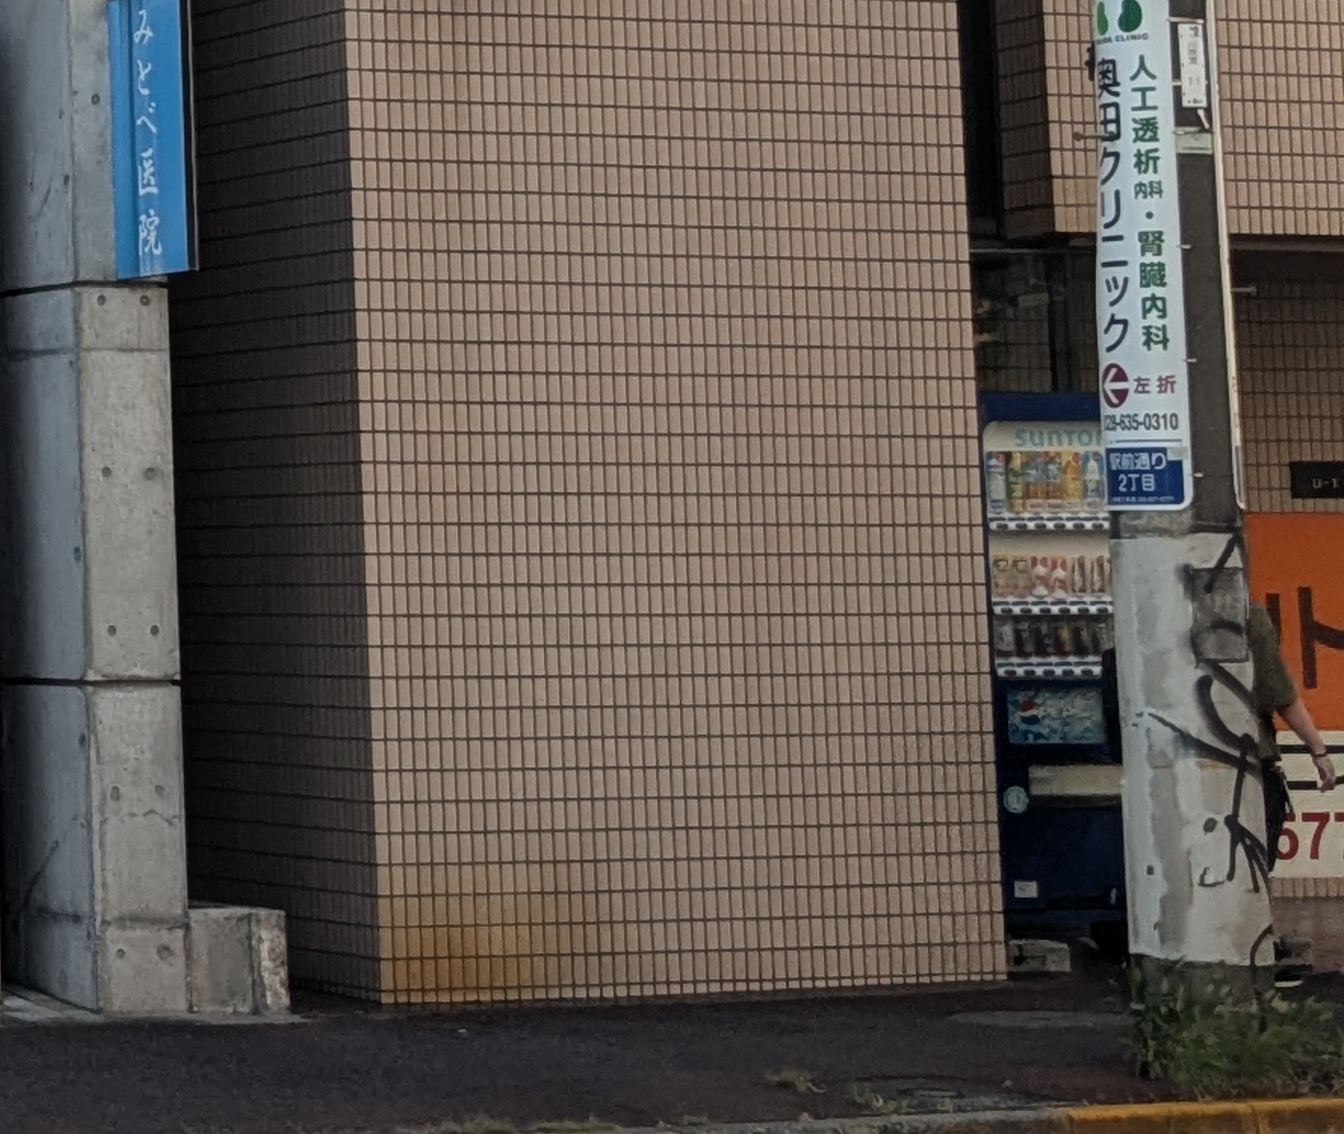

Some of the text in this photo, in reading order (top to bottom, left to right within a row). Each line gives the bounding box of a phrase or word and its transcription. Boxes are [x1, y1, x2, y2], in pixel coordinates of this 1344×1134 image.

[133, 9, 162, 256] みとべ医院
[1097, 56, 1129, 354] 奥田クリニック
[1133, 374, 1177, 395] 左折
[1109, 452, 1168, 471] 駅前通り
[1118, 473, 1156, 493] 2丁目
